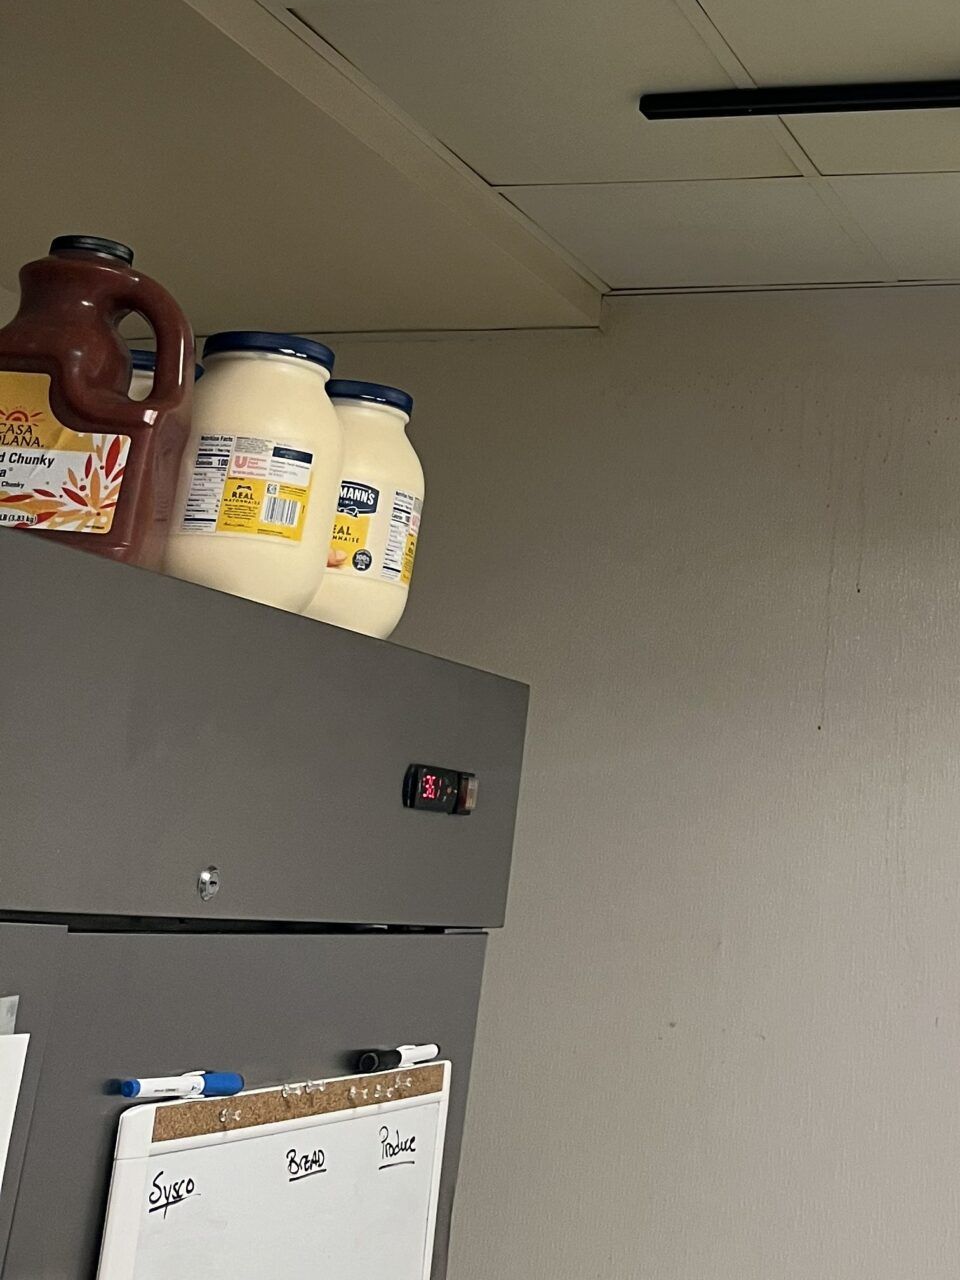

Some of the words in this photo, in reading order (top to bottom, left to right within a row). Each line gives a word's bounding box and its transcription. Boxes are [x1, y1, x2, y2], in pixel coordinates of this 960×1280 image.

[0, 434, 44, 448] LANA.
[9, 452, 55, 468] Chunky
[1, 481, 24, 489] Chunky
[232, 491, 254, 500] REAL
[379, 1126, 416, 1160] Produce
[149, 1171, 195, 1219] Sysco
